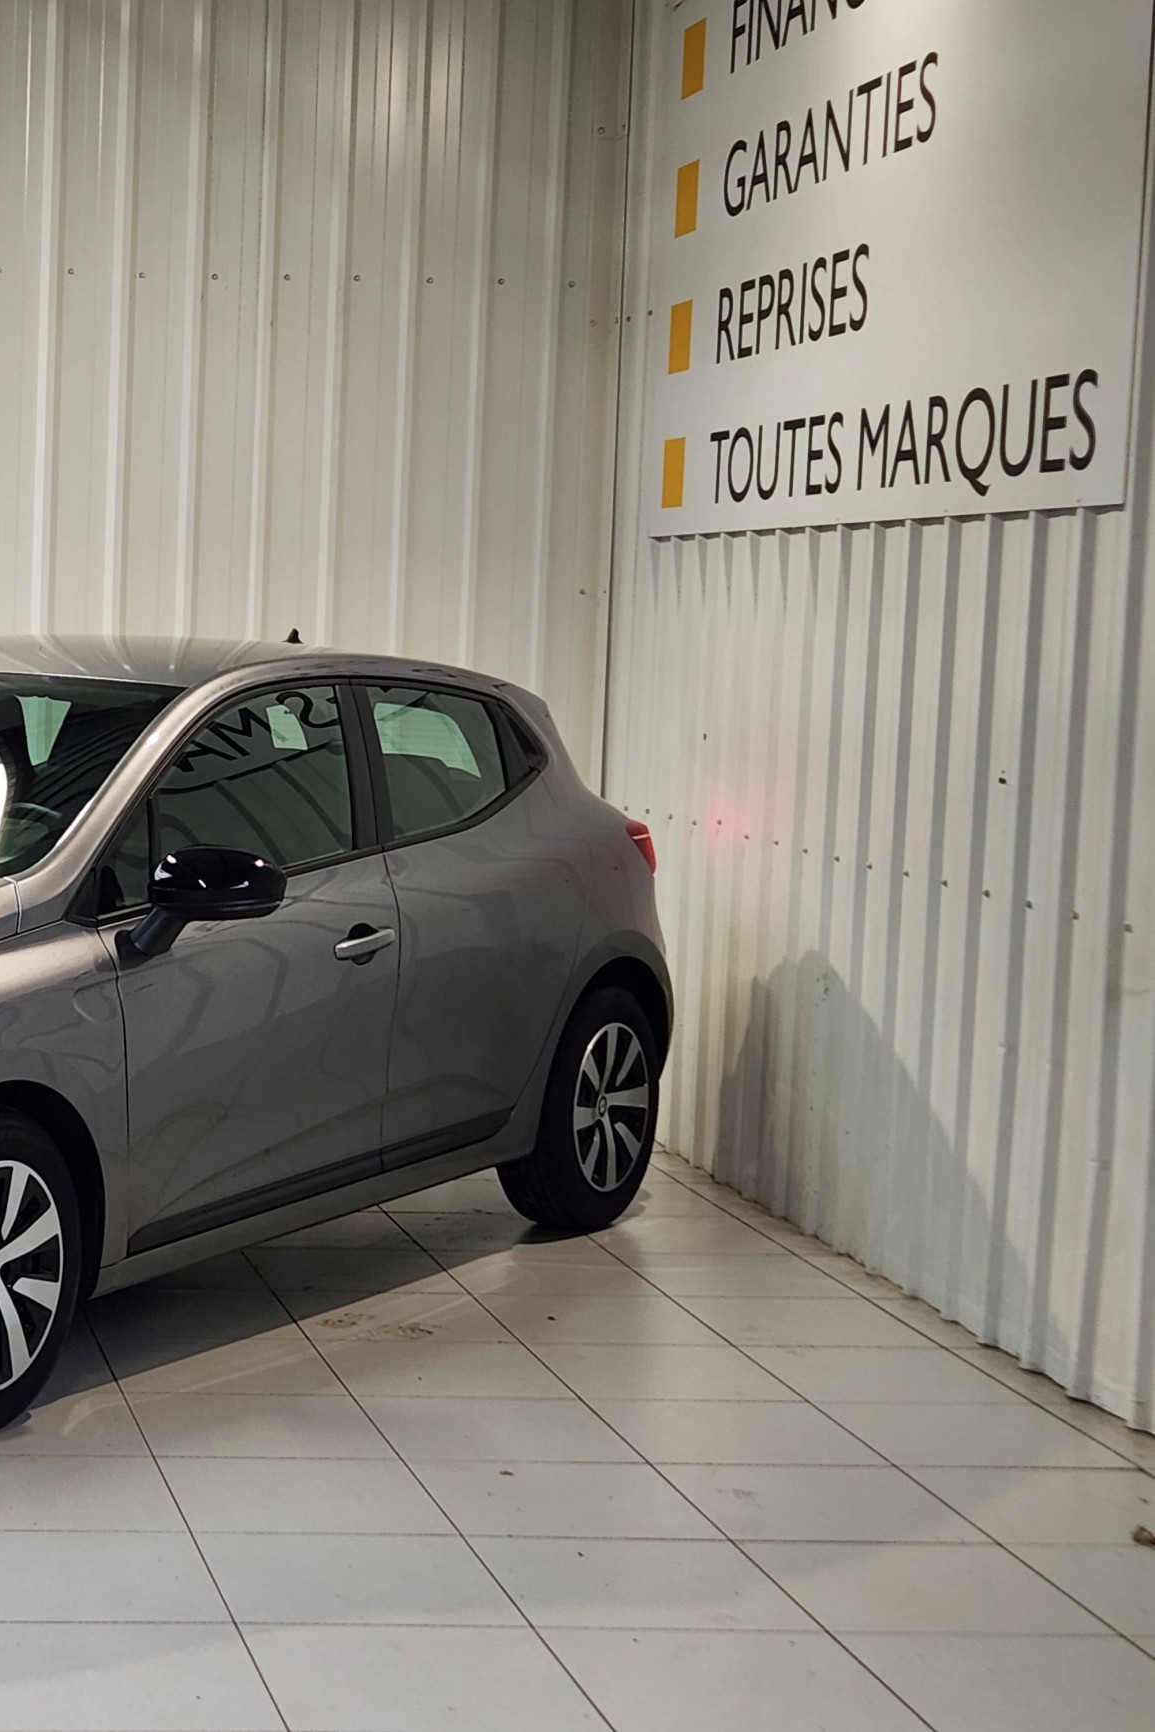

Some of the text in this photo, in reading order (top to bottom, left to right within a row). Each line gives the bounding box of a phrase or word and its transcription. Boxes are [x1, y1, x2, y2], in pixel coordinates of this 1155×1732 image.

[730, 0, 866, 74] FINA
[723, 52, 938, 217] GARANTIES
[716, 243, 870, 364] REPRISES
[710, 369, 1098, 504] TOUTES MARQUES
